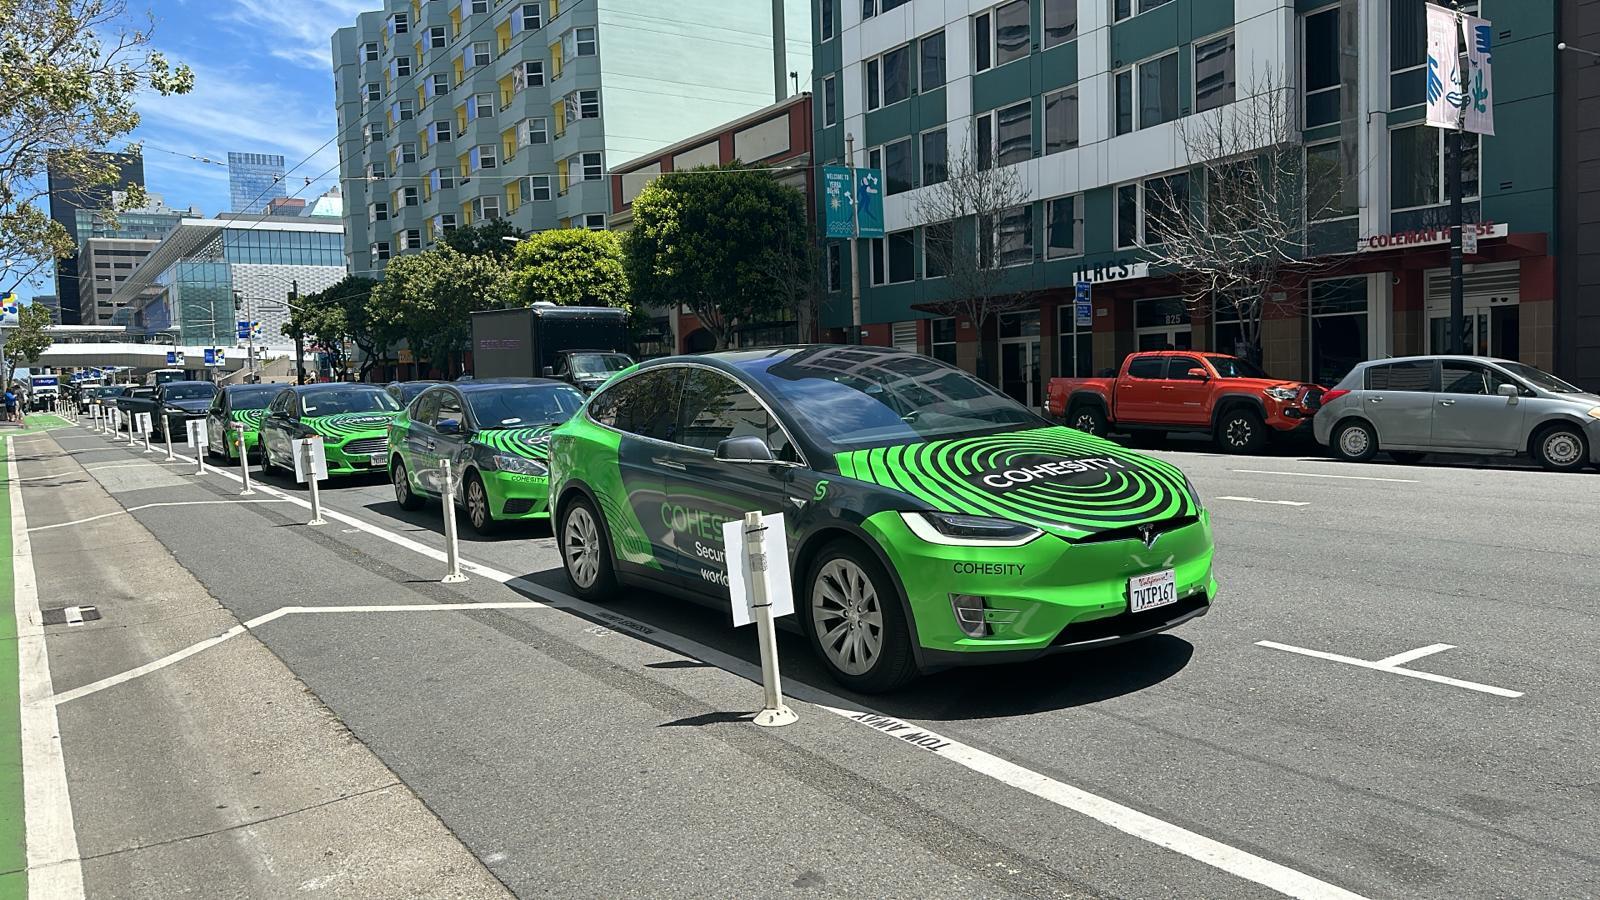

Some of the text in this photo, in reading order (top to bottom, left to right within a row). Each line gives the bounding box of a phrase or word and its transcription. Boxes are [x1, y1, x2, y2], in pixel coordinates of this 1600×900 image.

[1369, 228, 1438, 248] COLEMAN
[1442, 221, 1495, 241] HSE
[511, 475, 546, 483] COHESITY
[983, 457, 1125, 488] COHESITY
[953, 562, 1025, 576] COHESITY
[1133, 582, 1174, 608] 7VIP167
[851, 712, 951, 752] TOW AWAY
